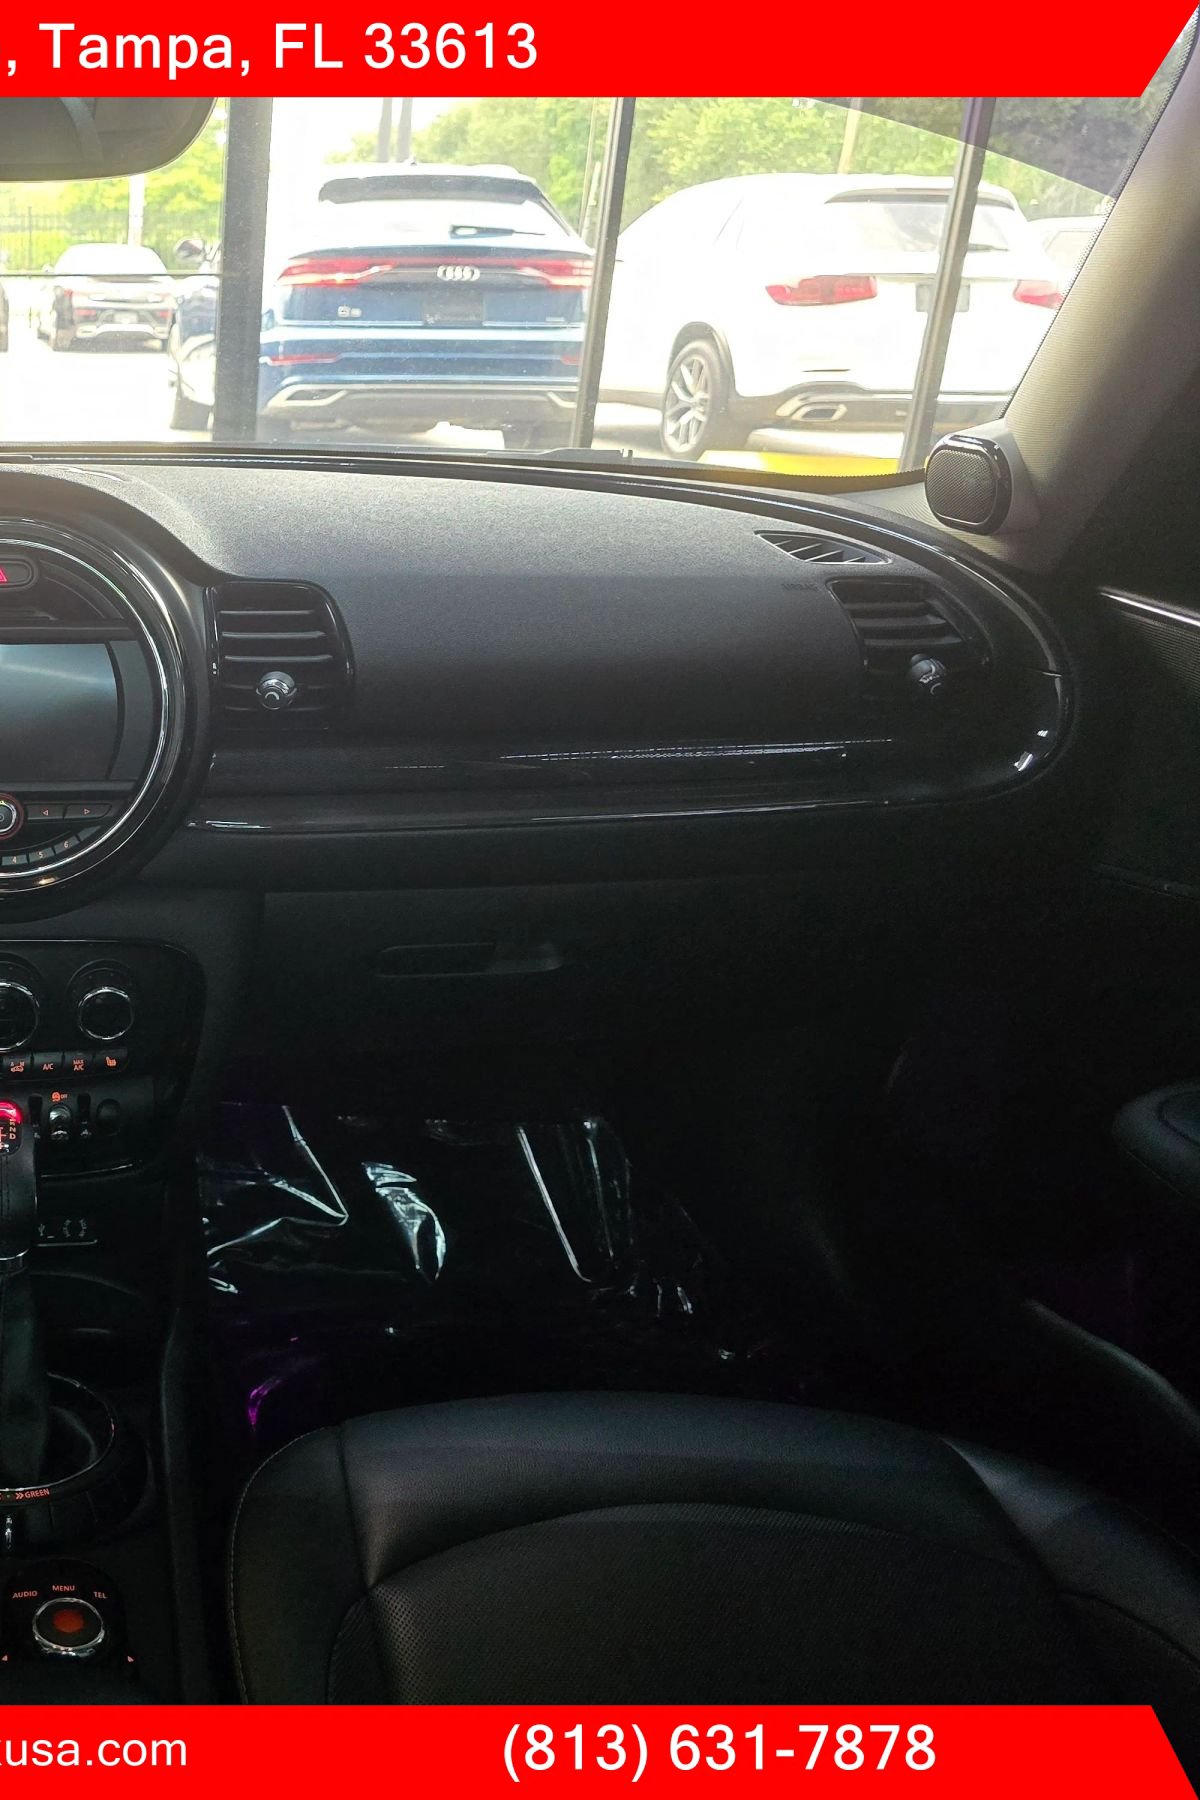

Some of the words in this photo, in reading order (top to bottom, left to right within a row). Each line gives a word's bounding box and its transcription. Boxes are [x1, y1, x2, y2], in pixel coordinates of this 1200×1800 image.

[24, 1488, 50, 1499] GREEN
[12, 1591, 39, 1599] AUDIO
[93, 1592, 107, 1600] TEL
